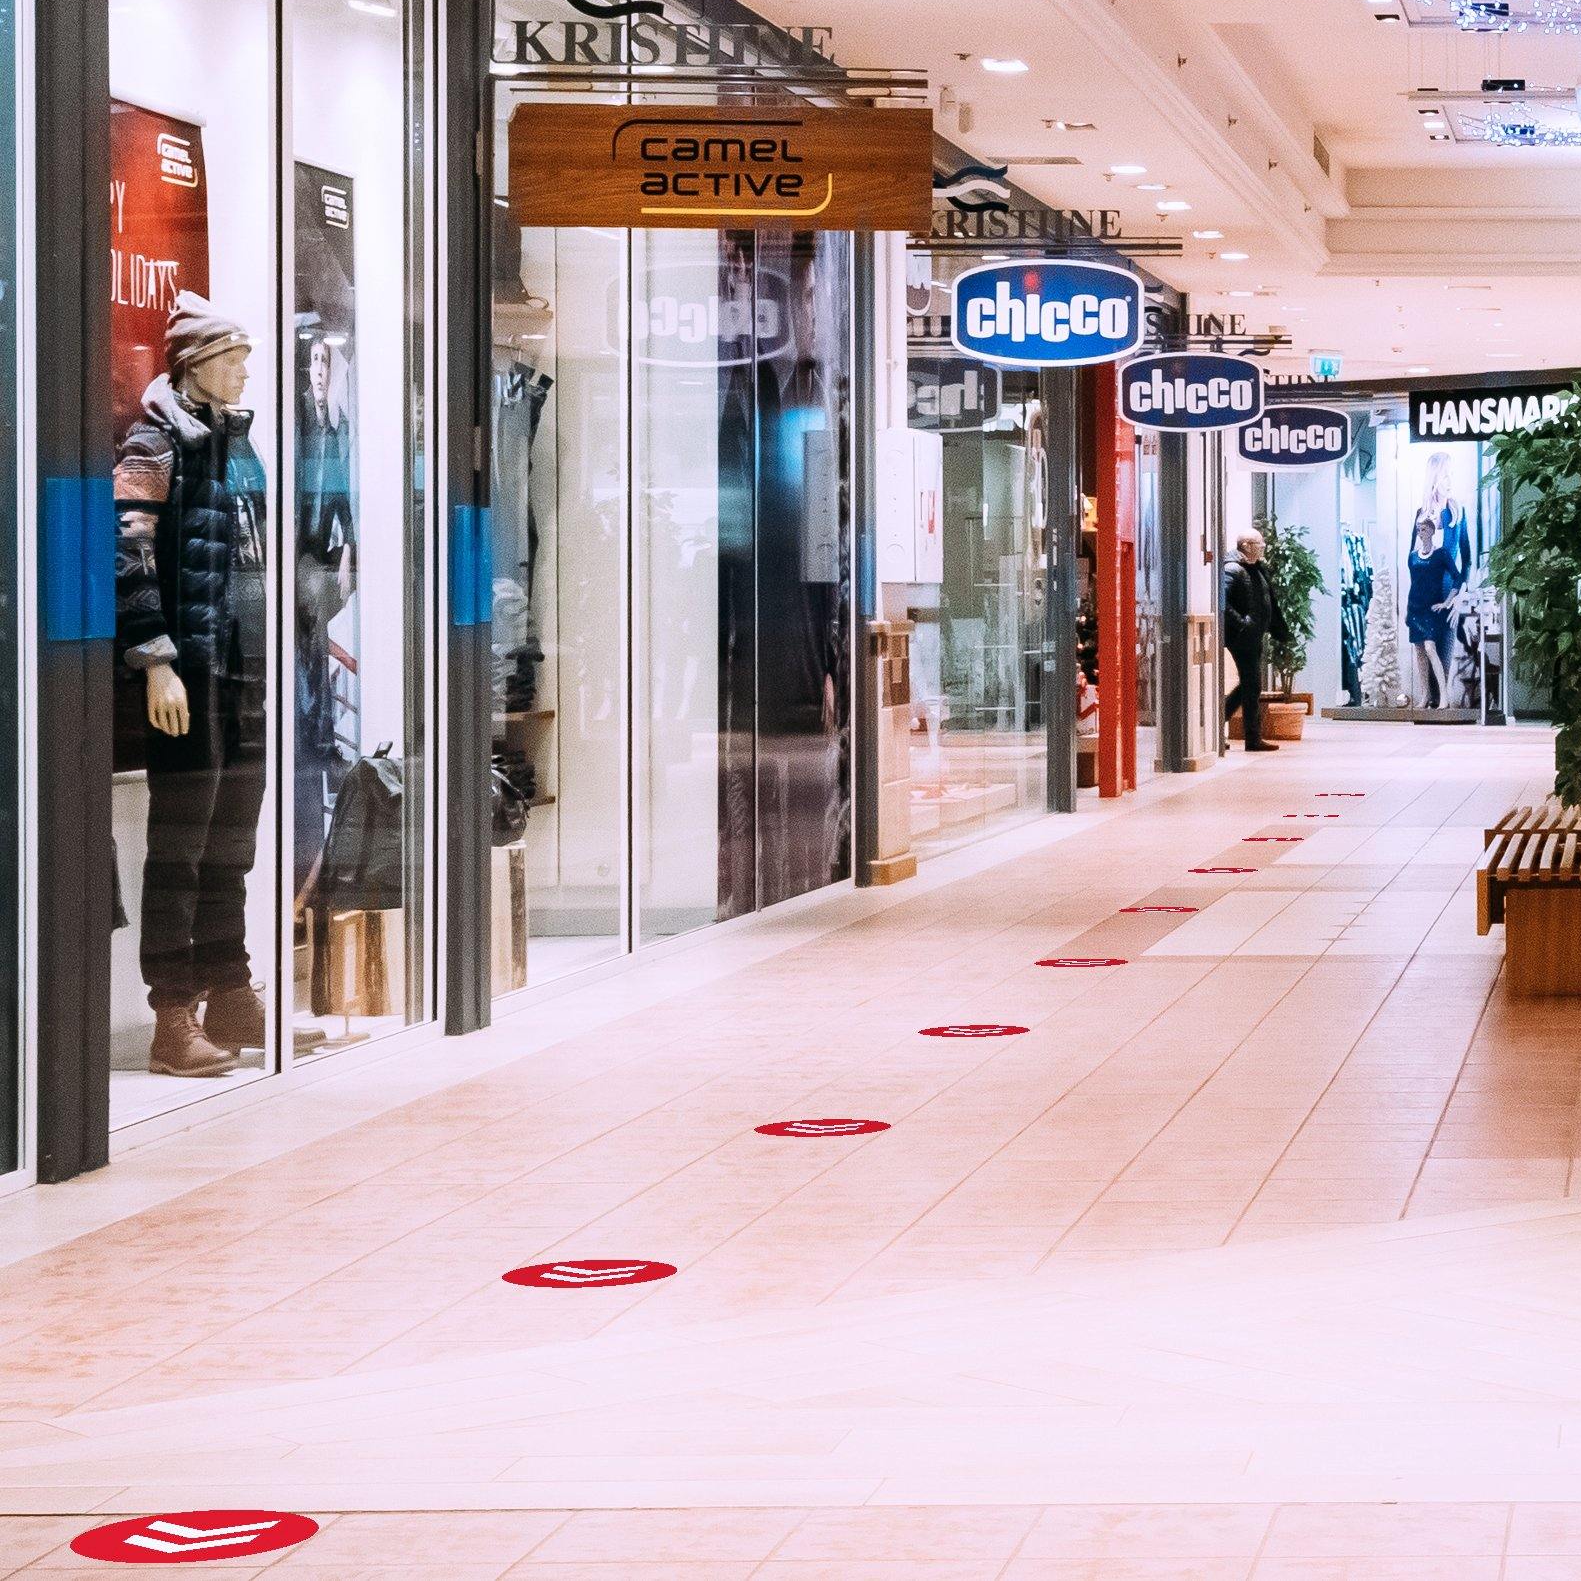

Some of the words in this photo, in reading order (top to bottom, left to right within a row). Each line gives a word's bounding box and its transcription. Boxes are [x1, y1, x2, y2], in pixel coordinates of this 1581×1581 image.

[966, 272, 1129, 343] chicco
[1129, 366, 1253, 415] chicco
[1244, 416, 1343, 455] chicco
